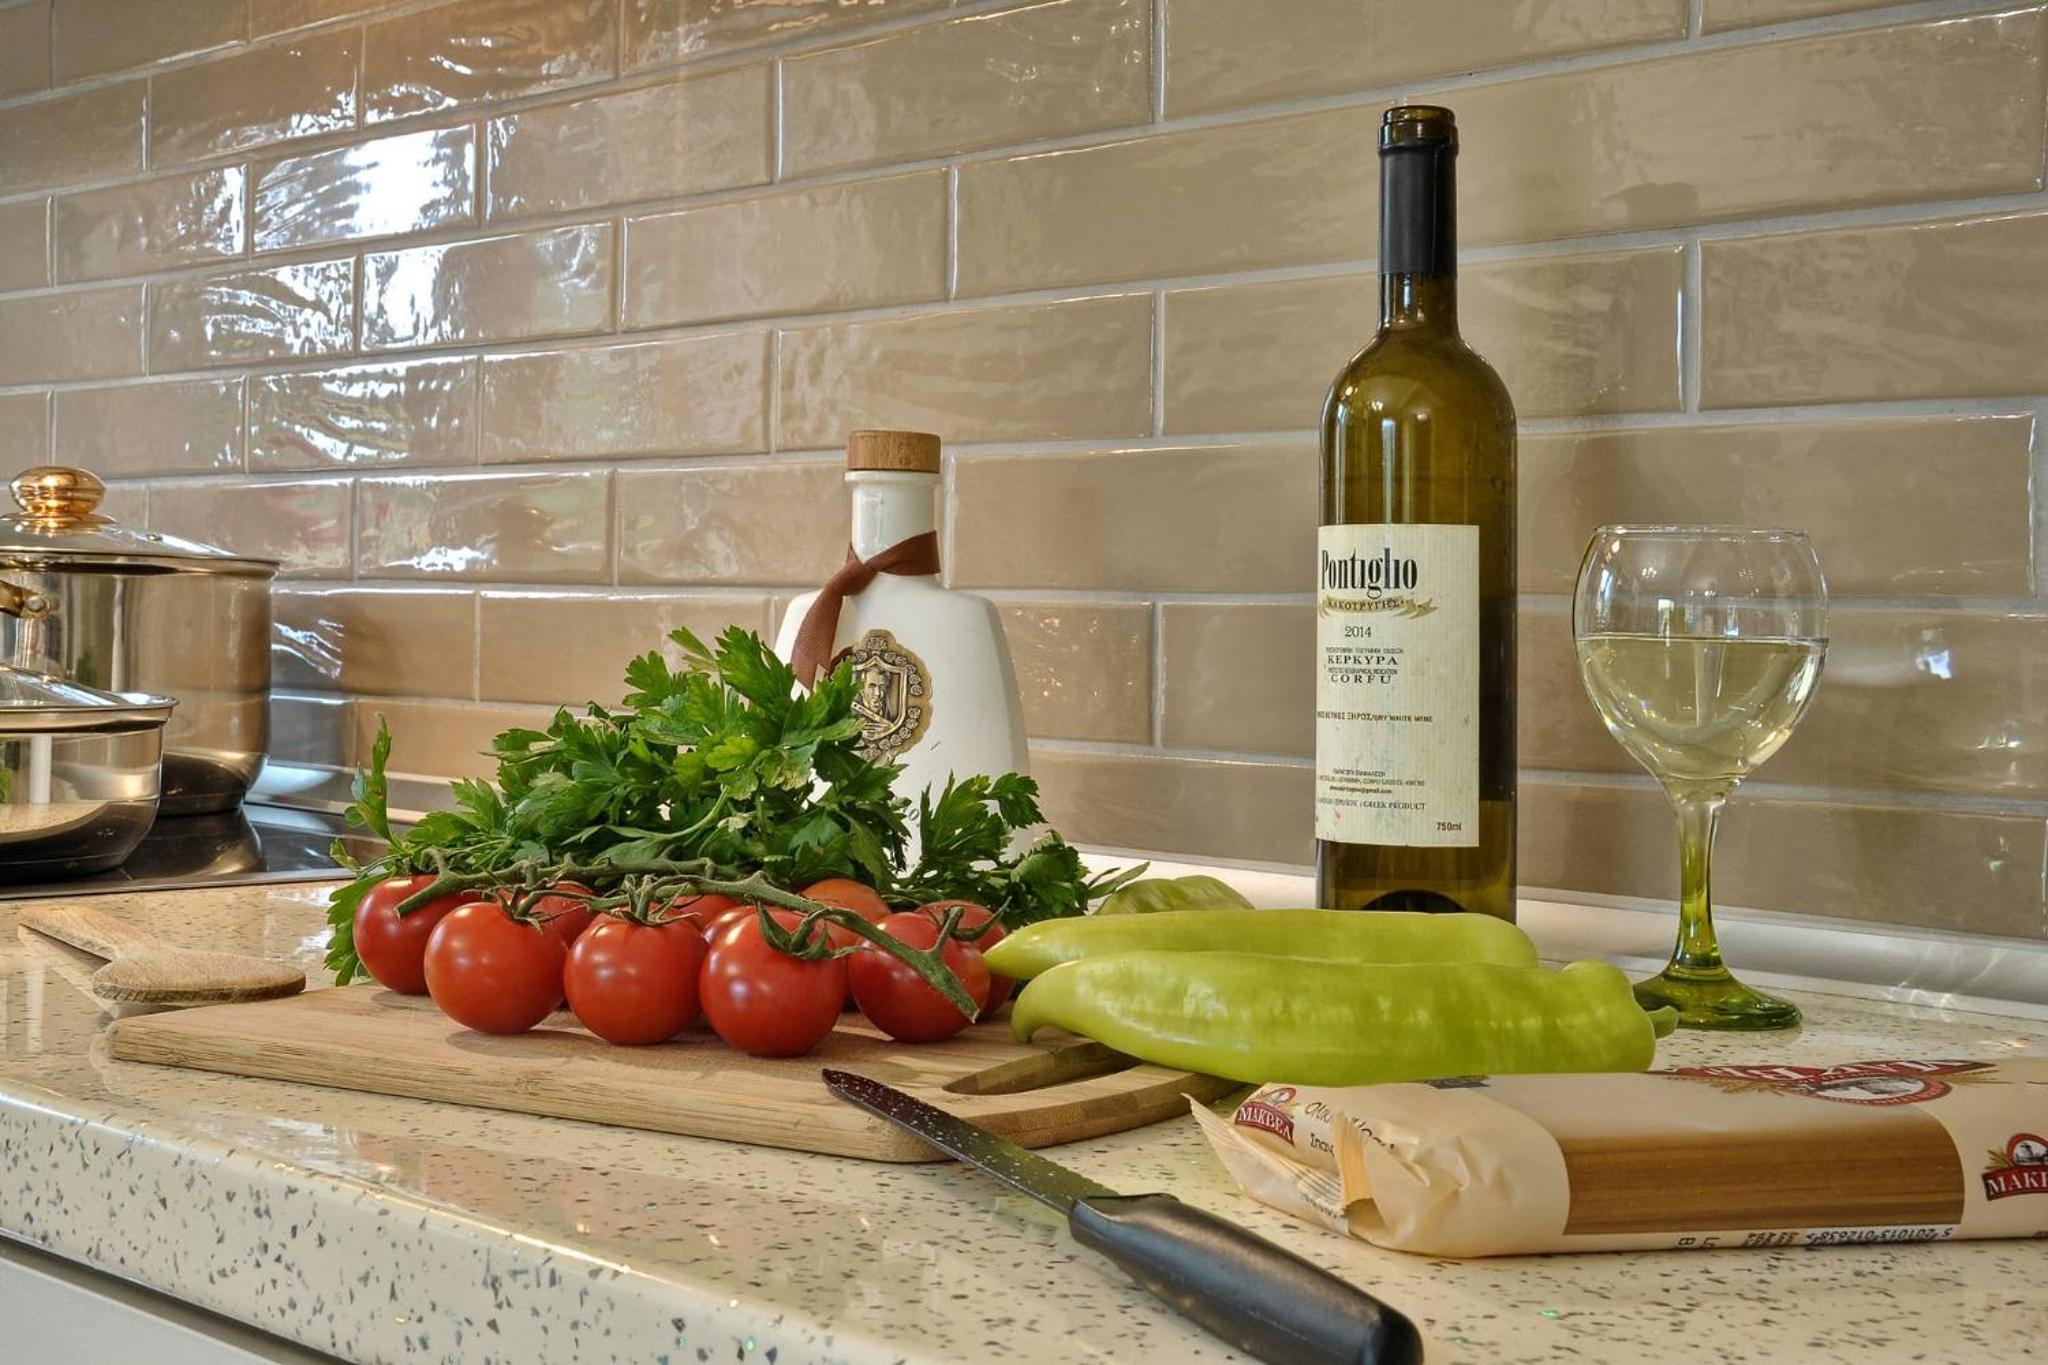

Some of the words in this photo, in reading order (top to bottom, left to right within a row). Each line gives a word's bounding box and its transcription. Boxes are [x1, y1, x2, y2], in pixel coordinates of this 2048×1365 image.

[1321, 547, 1418, 599] Pontiglio
[1344, 626, 1372, 638] 2014
[1327, 654, 1399, 666] ΚΕΡΚΥΡΑ
[1331, 674, 1392, 685] CORFU
[1436, 822, 1462, 832] 750ml
